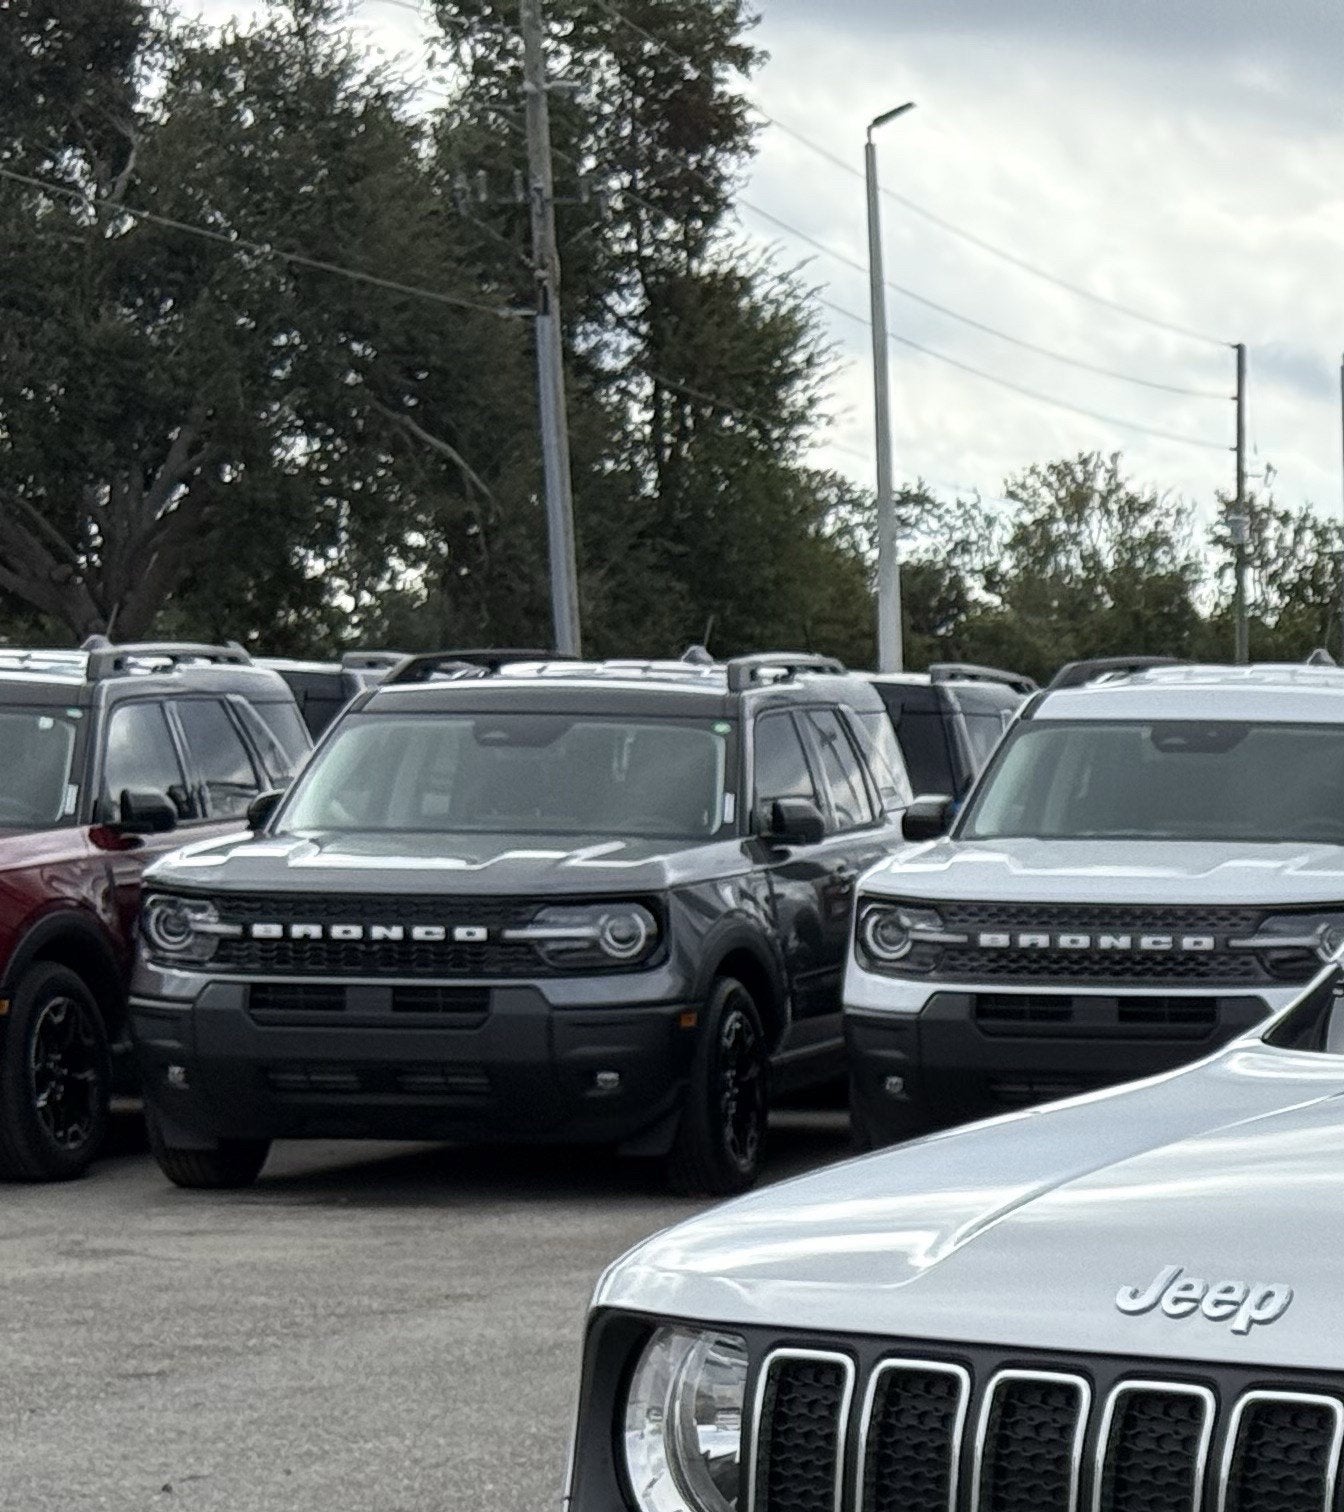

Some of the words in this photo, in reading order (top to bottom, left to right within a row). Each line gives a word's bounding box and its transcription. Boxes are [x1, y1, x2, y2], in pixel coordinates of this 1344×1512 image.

[252, 923, 488, 942] BRONCO
[979, 933, 1215, 950] BRONCO
[1115, 1264, 1295, 1336] Jeep
